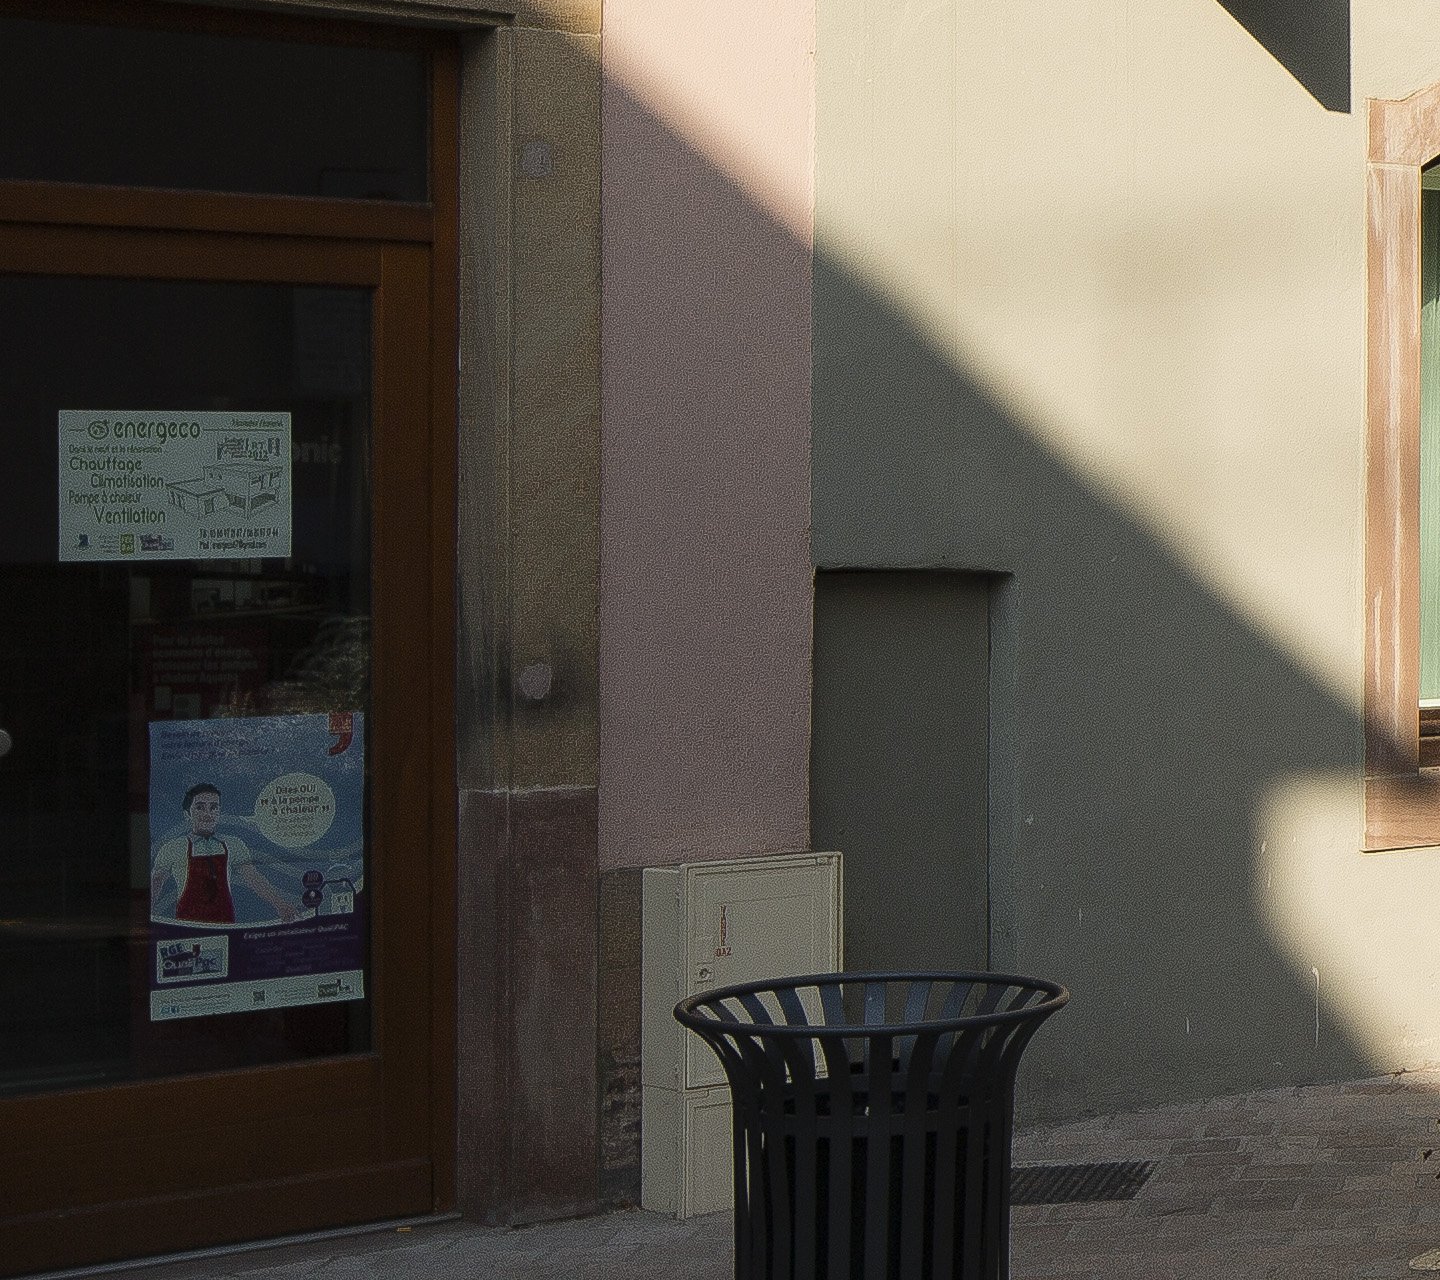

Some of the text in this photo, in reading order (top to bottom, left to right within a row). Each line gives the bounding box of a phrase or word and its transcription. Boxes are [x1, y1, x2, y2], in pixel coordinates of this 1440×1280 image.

[113, 420, 201, 444] energeco
[248, 450, 268, 458] 2012
[69, 456, 143, 474] Chauffage
[90, 473, 164, 488] Climatisation
[69, 490, 141, 507] Pompe à chaleur
[94, 506, 166, 524] Ventilation
[275, 785, 316, 795] Dites OUI
[279, 796, 287, 804] la
[289, 796, 319, 804] pompe
[272, 805, 319, 815] à chaleur
[160, 943, 183, 957] RGE
